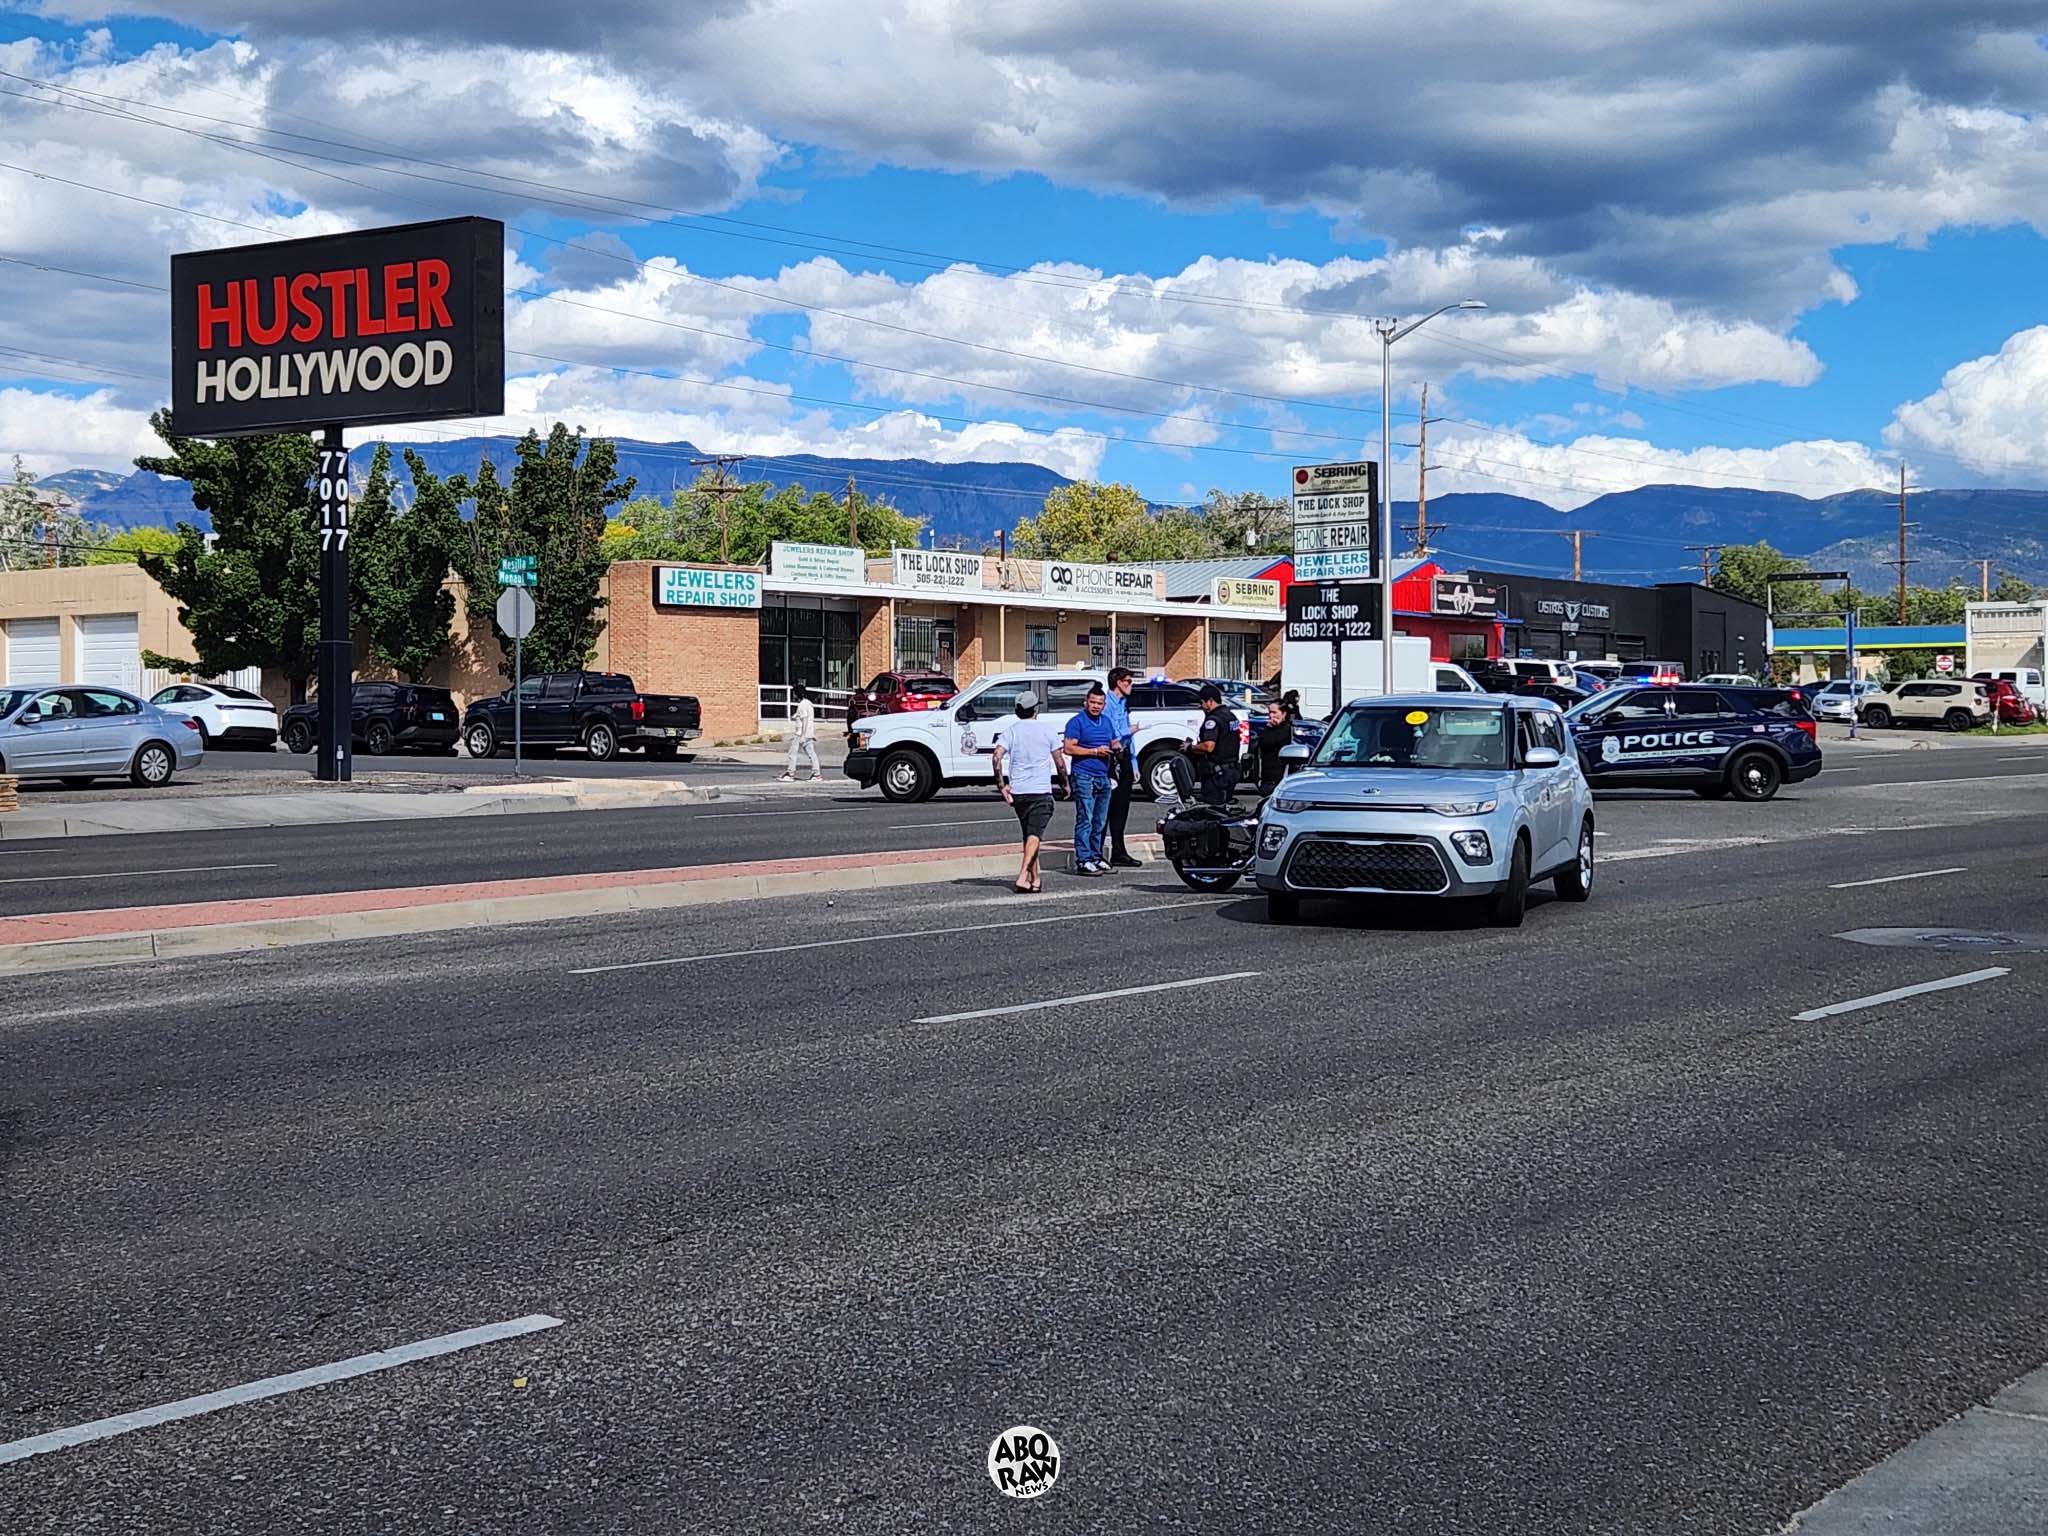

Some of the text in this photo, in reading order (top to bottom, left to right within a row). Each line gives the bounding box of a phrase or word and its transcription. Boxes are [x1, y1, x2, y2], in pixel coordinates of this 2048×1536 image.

[197, 259, 453, 349] HUSTLER
[196, 340, 453, 403] HOLLYWOOD
[1313, 465, 1367, 479] SEBRING
[1298, 496, 1365, 512] THE LOCK SHOP
[1296, 525, 1368, 549] PHONE REPAIR
[901, 553, 980, 576] THE LOCK SHOP
[1296, 552, 1368, 568] JEWELERS
[916, 573, 965, 586] 505-221-1222
[1075, 568, 1115, 587] PHONE
[1114, 571, 1153, 589] REPAIR
[1296, 564, 1369, 578] REPAIR SHOP
[666, 570, 756, 591] JEWELERS
[666, 589, 756, 606] REPAIR SHOP
[1235, 583, 1275, 596] SEBRING
[1320, 588, 1340, 603] THE
[1301, 604, 1358, 621] LOCK SHOP
[1289, 621, 1372, 638] (505) 221-1222
[1623, 731, 1715, 749] POLICE
